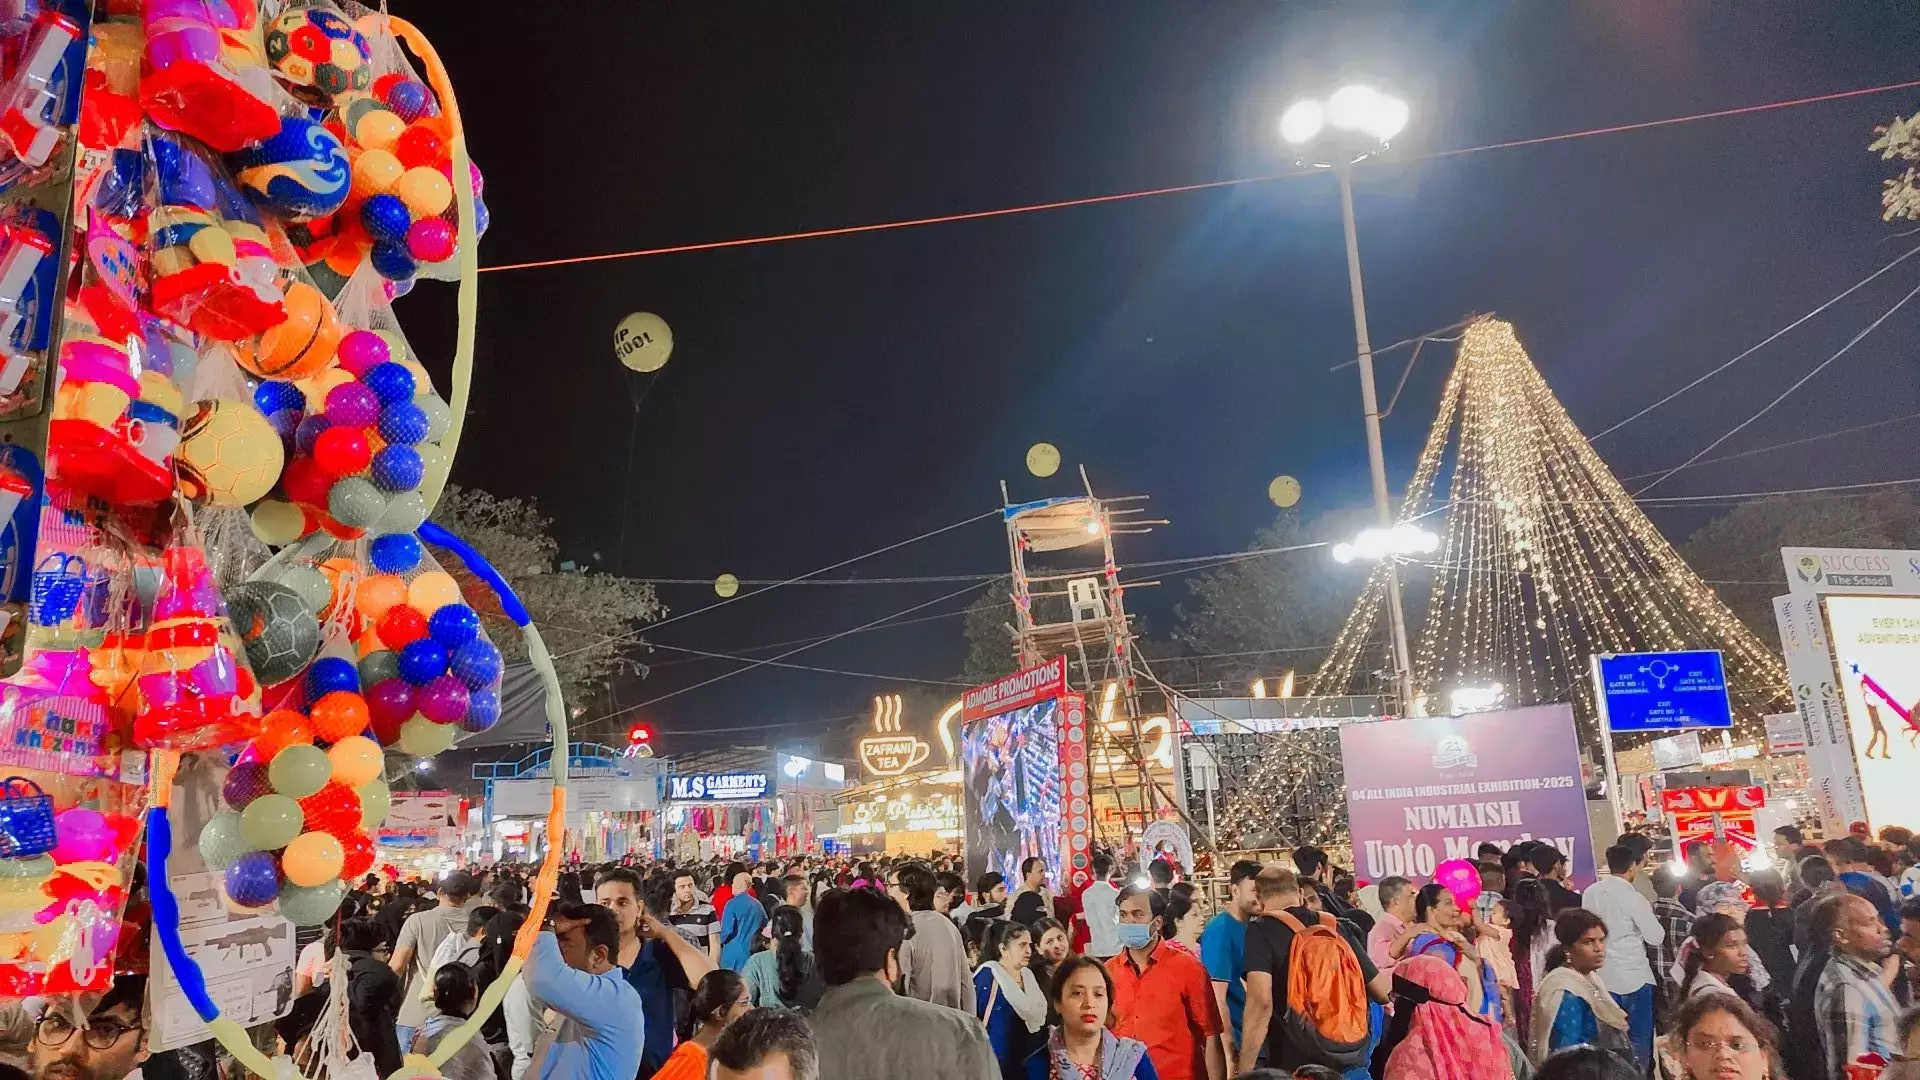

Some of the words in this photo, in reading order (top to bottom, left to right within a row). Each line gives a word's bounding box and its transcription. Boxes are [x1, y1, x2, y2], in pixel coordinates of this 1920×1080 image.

[1822, 554, 1890, 572] SUCCESS
[1832, 575, 1852, 585] The
[1854, 575, 1888, 586] School
[966, 685, 998, 710] ADMORE
[999, 660, 1060, 699] PROMOTIONS
[866, 742, 912, 756] ZAFRANI
[877, 756, 899, 769] TEA
[671, 776, 705, 799] M.S
[706, 774, 767, 789] GARMENTS
[1367, 788, 1384, 800] ALL
[1384, 787, 1414, 799] INDIA
[1415, 783, 1478, 797] INDUSTRIAL
[1478, 776, 1575, 793] EXHIBITION-2025
[1403, 801, 1523, 831] NUMAISH
[1364, 837, 1436, 879] Upto
